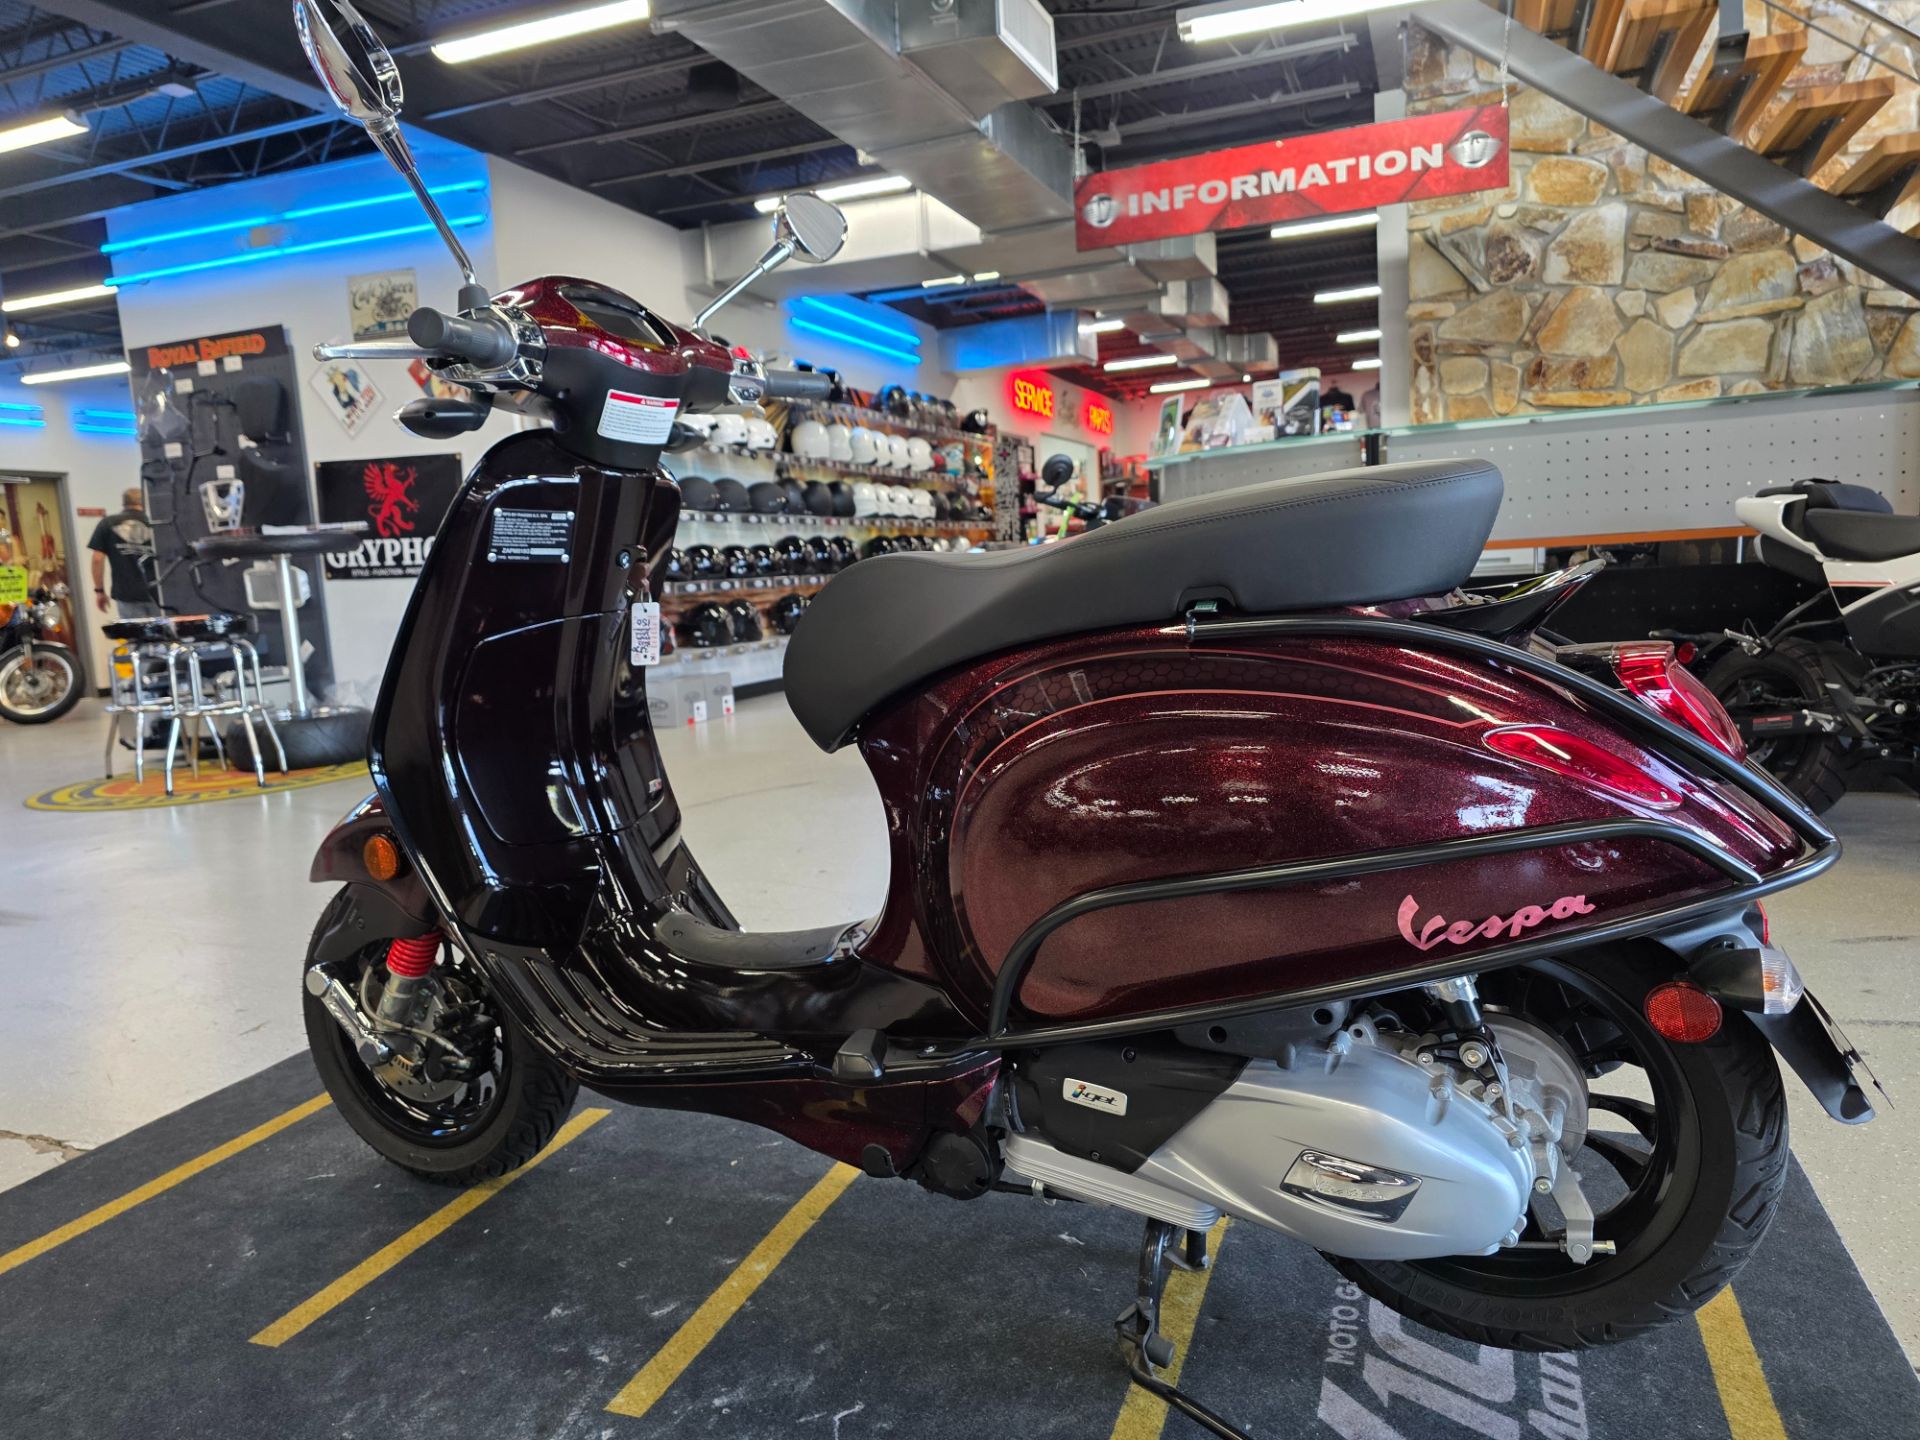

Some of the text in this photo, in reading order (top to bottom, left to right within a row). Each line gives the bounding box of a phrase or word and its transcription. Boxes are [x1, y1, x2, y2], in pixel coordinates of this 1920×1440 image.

[1127, 143, 1443, 217] INFORMATION
[148, 345, 199, 369] ROYAL
[198, 333, 266, 361] ENFIELD
[1014, 378, 1054, 418] SERVICE
[1089, 405, 1112, 434] PARTS
[1397, 894, 1597, 951] Vespa
[1325, 1304, 1361, 1365] MOTO
